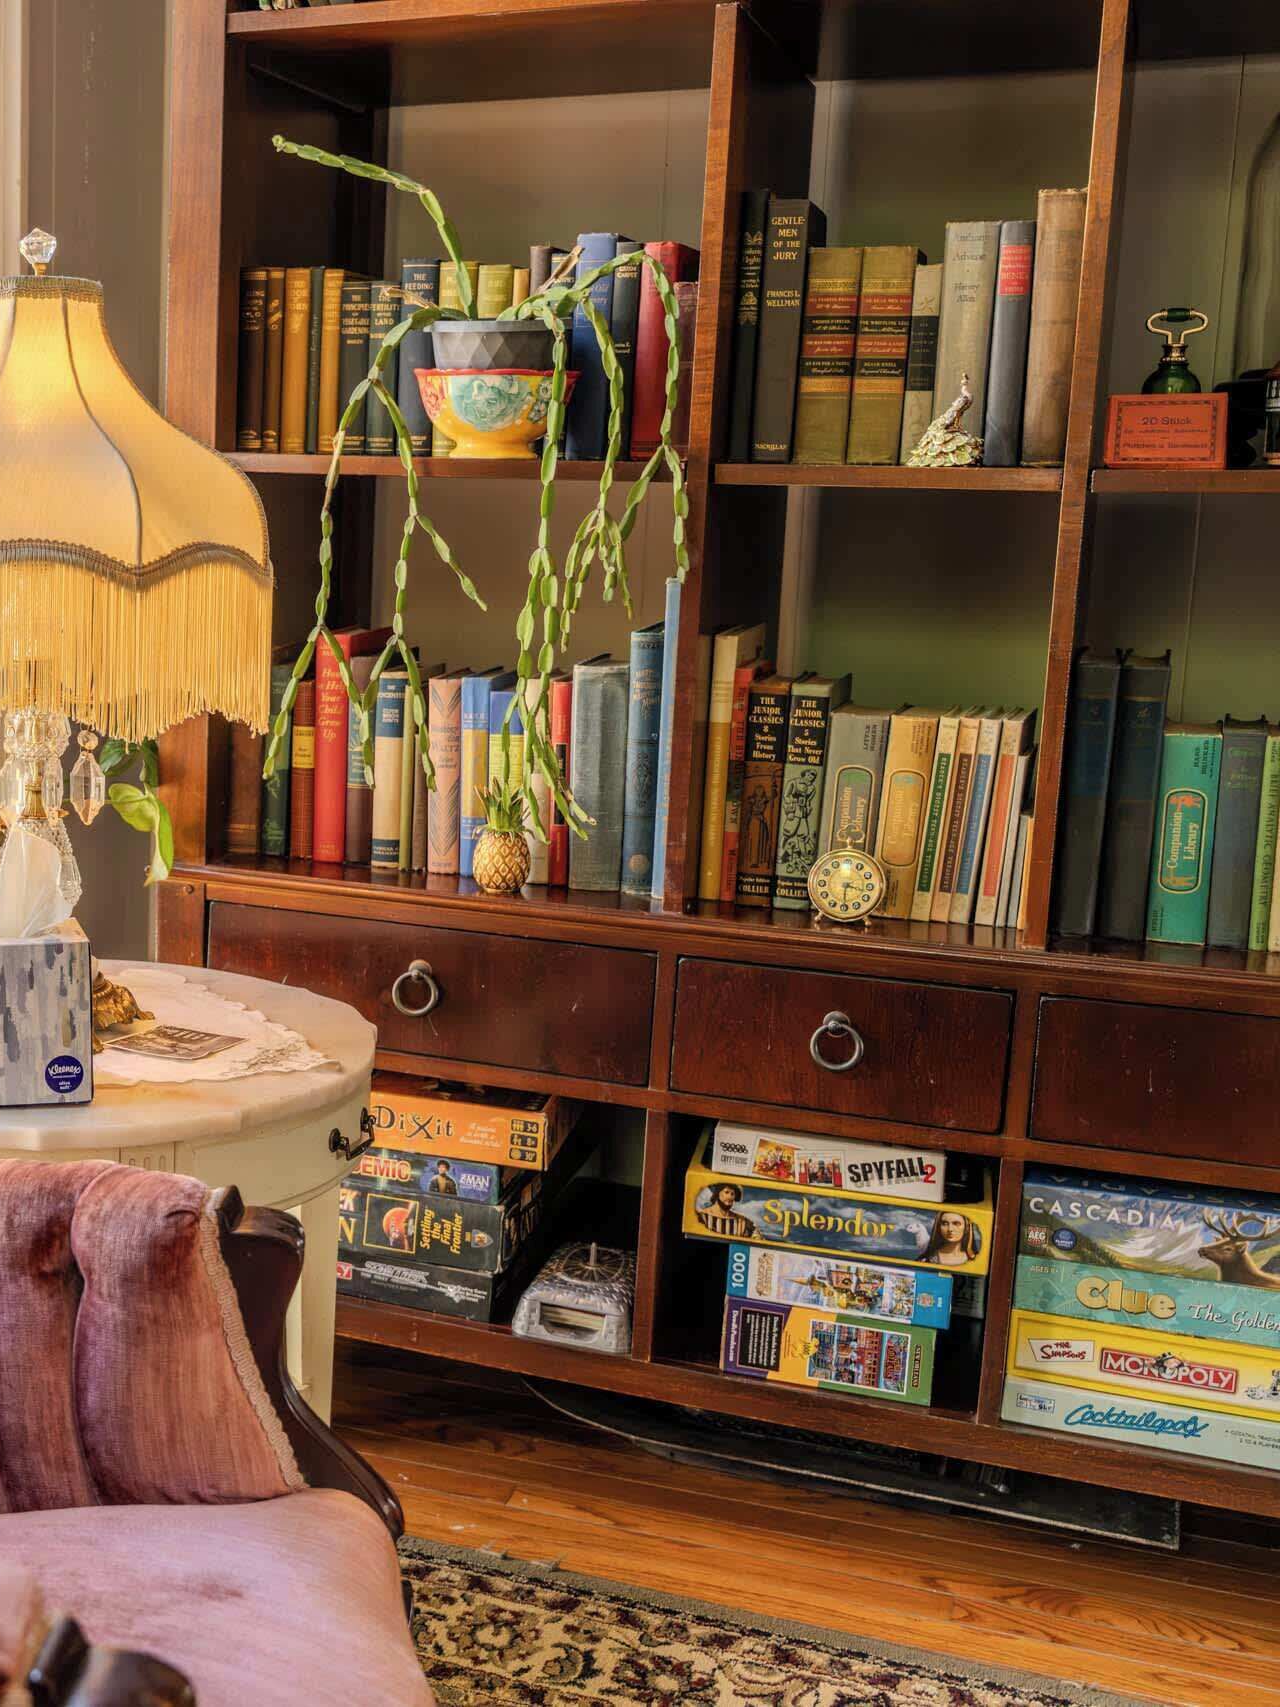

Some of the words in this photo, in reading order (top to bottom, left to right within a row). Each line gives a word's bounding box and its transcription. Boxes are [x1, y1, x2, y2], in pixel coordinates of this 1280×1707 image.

[771, 216, 805, 225] GENTLE-
[778, 229, 798, 237] MEN
[773, 251, 798, 261] JURY
[413, 273, 427, 281] THE
[767, 290, 794, 298] FRANCIS
[766, 299, 800, 308] WELLMAN
[375, 318, 394, 326] LAND
[1142, 416, 1157, 425] 20
[760, 696, 775, 705] THE
[801, 700, 816, 708] THE
[752, 706, 781, 715] JUNIOR
[794, 709, 822, 718] JUNIOR
[749, 715, 784, 724] CLASSICS
[790, 718, 826, 728] CLASSICS
[323, 729, 337, 741] Up
[755, 733, 776, 742] Stories
[870, 724, 878, 752] WOMEN
[756, 742, 774, 750] From
[794, 736, 817, 746] Stories
[787, 744, 802, 753] That
[804, 747, 823, 755] Never
[752, 750, 776, 761] History
[789, 754, 806, 762] Grow
[808, 756, 820, 764] Old
[888, 789, 904, 844] Companion
[904, 802, 918, 839] Library
[1263, 803, 1278, 850] ANALYTIC
[1166, 811, 1183, 869] Companion
[1183, 822, 1199, 861] Library
[1258, 854, 1273, 906] GEOMETRY
[738, 885, 769, 894] COLLIER
[776, 887, 808, 897] COLLIER
[847, 1156, 927, 1184] SPYFALL
[923, 1163, 937, 1184] 2
[762, 1196, 896, 1239] Splendor
[1029, 1197, 1177, 1231] CASCADIA
[421, 1207, 436, 1250] Settling
[431, 1221, 441, 1239] the
[440, 1218, 453, 1246] Final
[450, 1212, 464, 1255] Frontier
[1028, 1231, 1046, 1241] AEG
[731, 1252, 746, 1289] 1000
[1075, 1275, 1177, 1319] Clue
[1185, 1303, 1227, 1324] The
[1230, 1430, 1256, 1438] COCKTAIL
